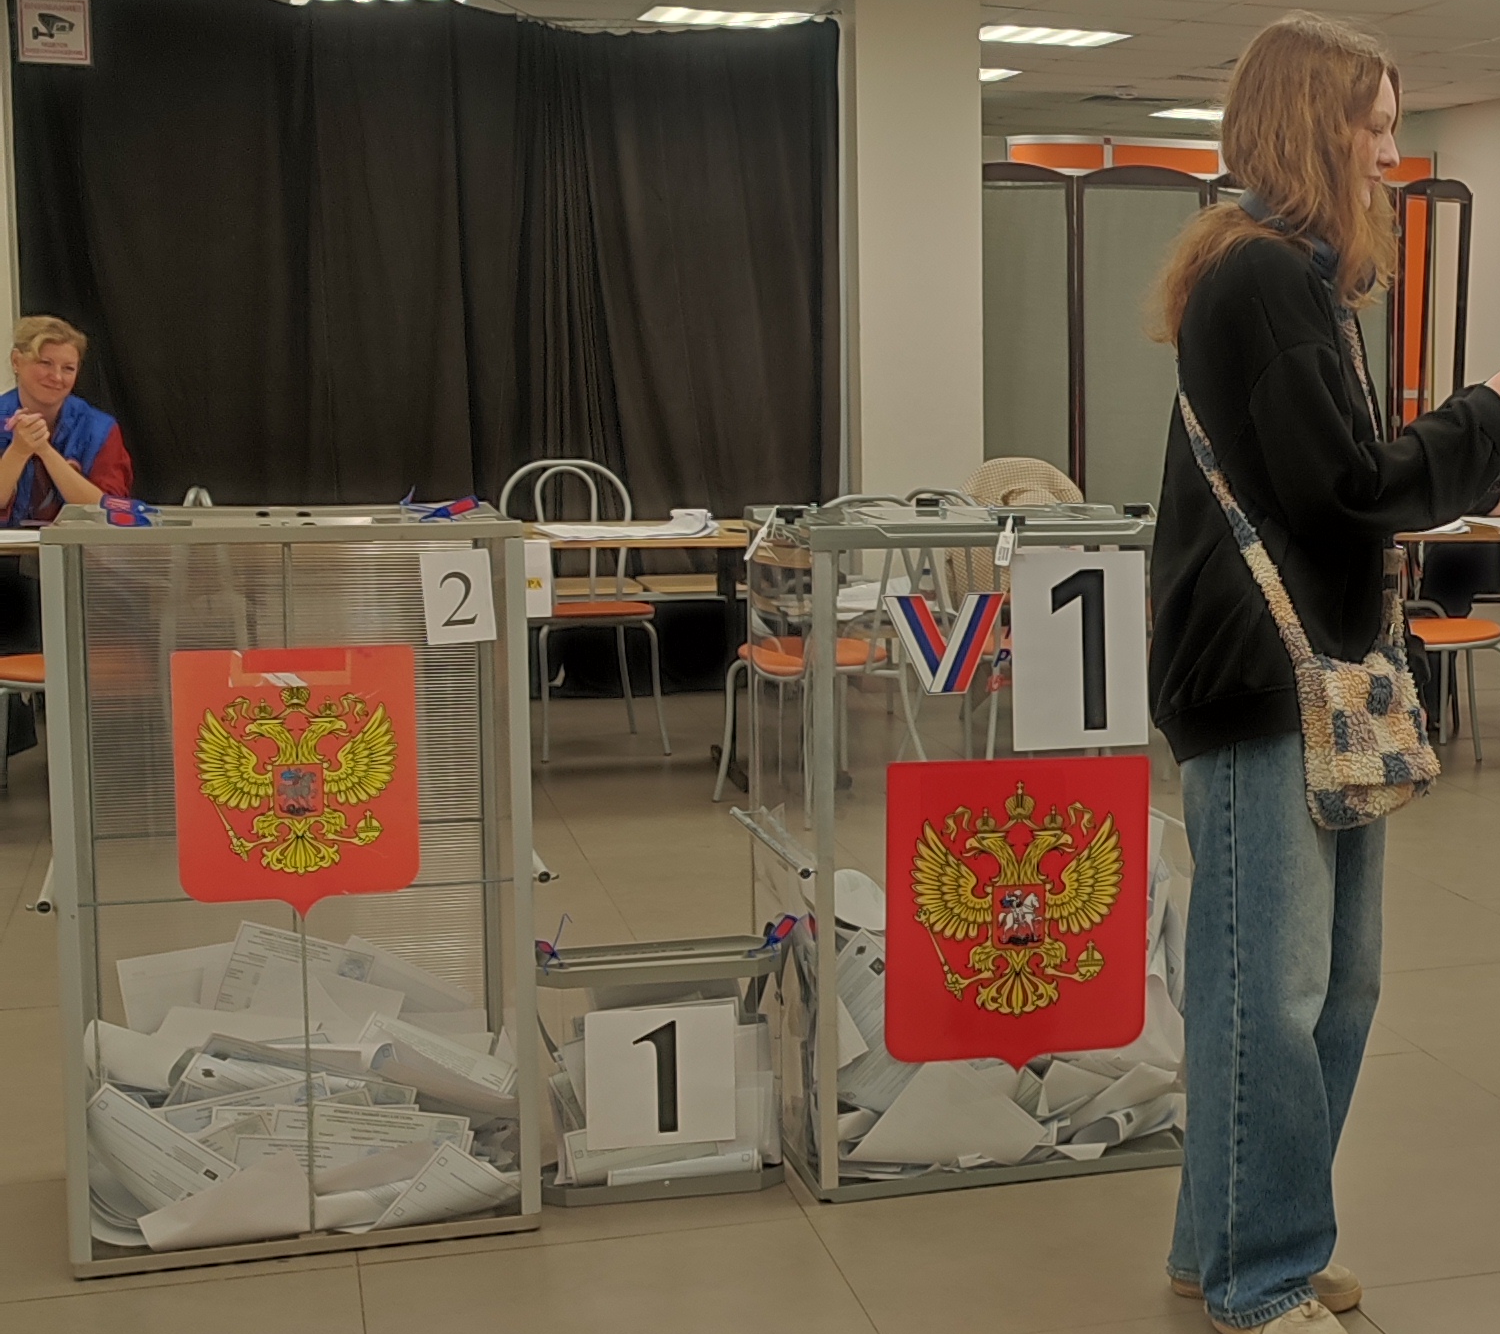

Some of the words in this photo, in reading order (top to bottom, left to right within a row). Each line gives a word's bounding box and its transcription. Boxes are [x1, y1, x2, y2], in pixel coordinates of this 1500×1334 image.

[439, 571, 478, 627] 2
[1051, 568, 1107, 731] 1
[632, 1020, 679, 1133] 1
